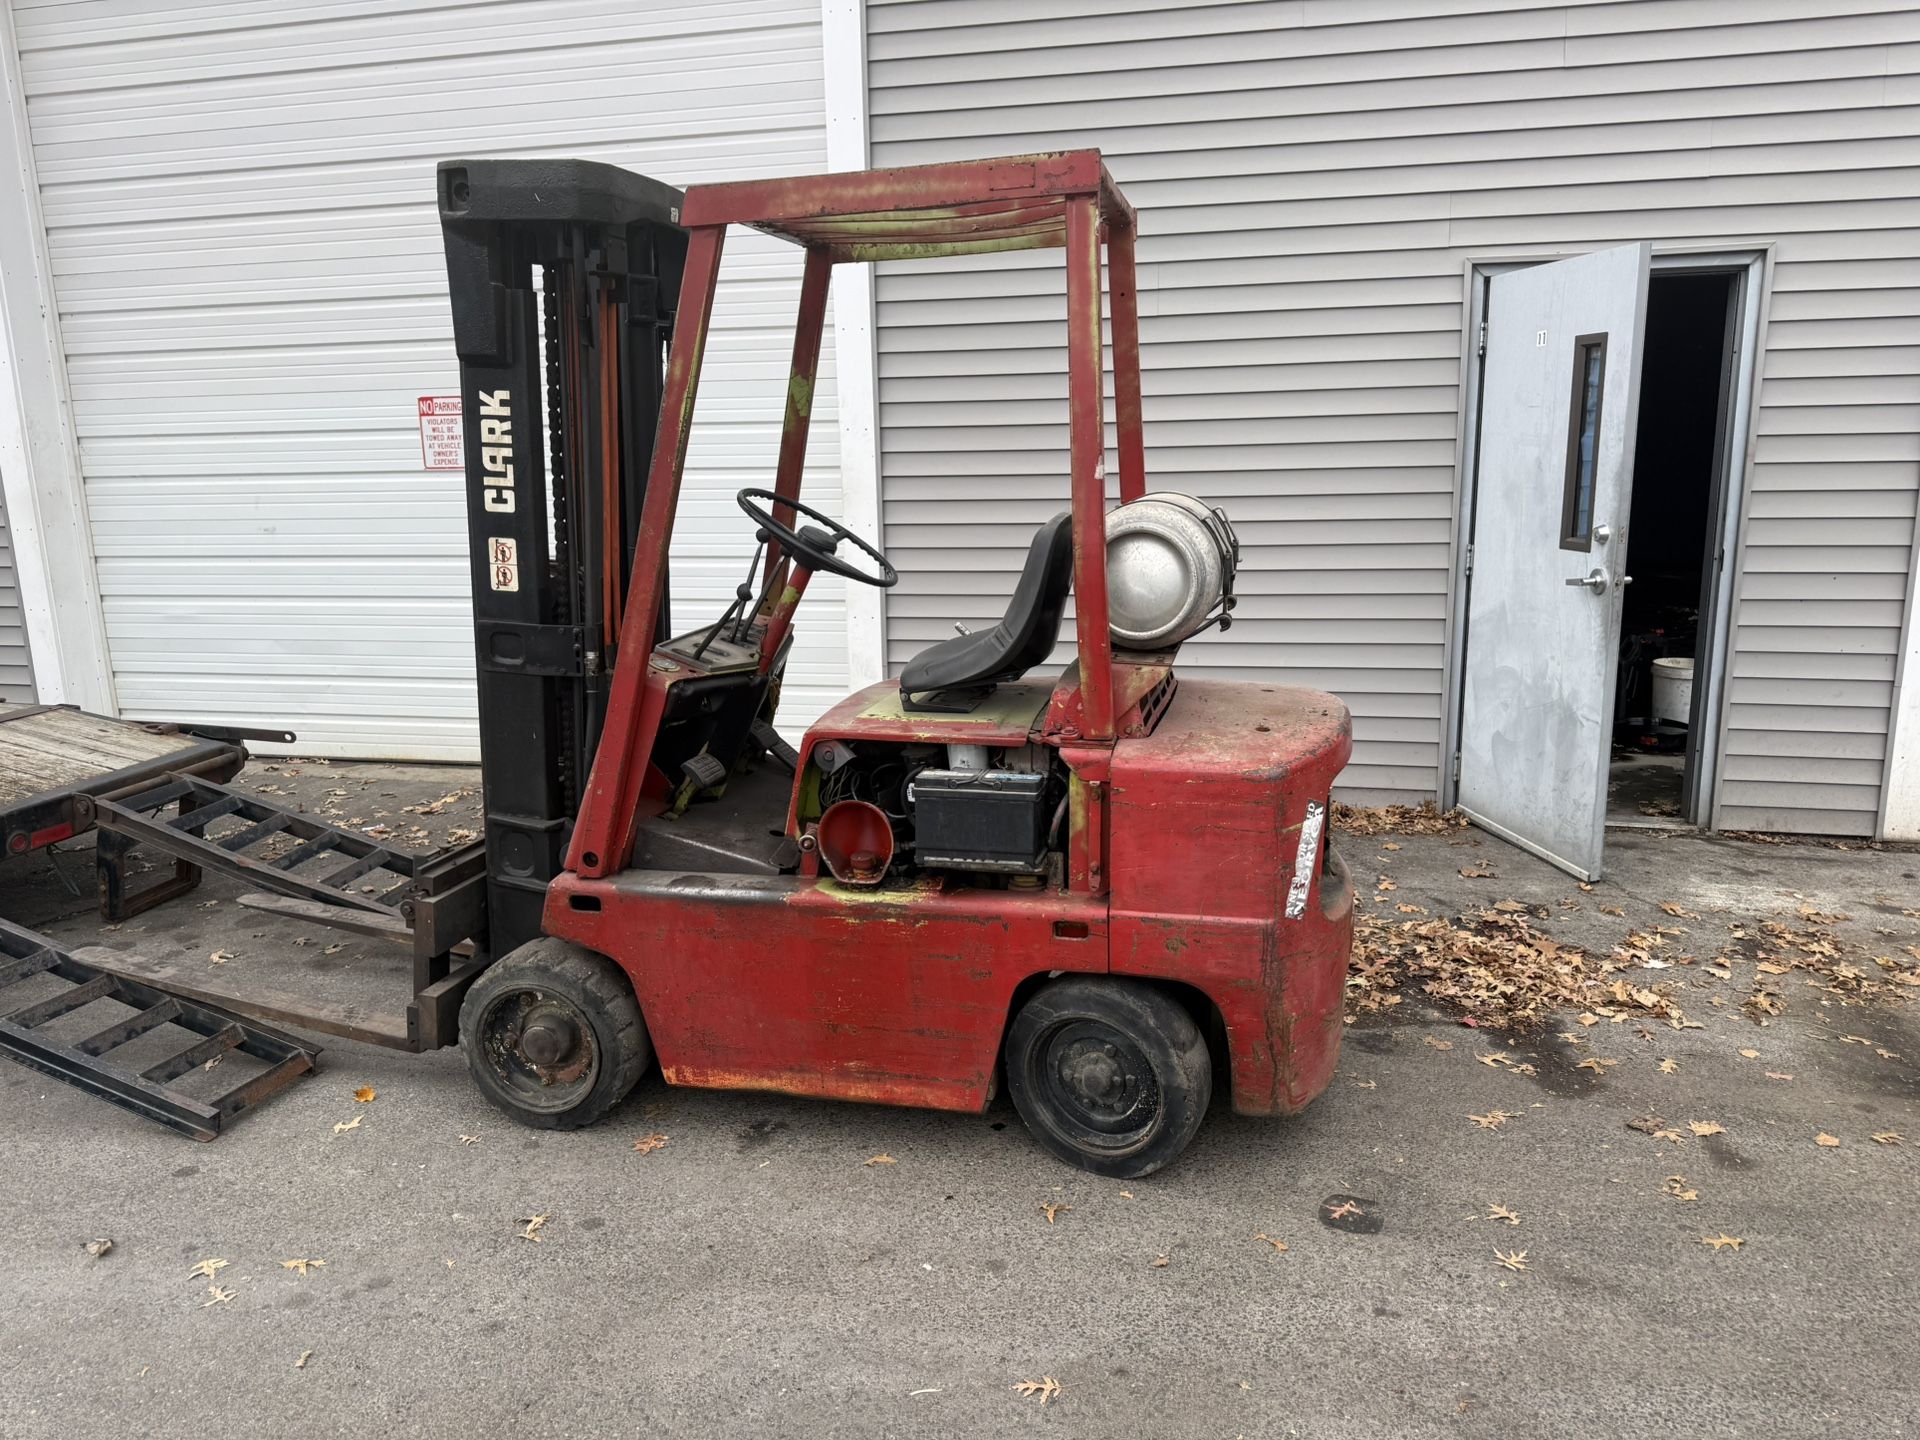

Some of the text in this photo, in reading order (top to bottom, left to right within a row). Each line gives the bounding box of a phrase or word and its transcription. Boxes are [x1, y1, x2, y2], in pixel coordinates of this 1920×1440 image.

[420, 400, 462, 414] NO PARKING
[427, 418, 458, 426] VIOLATORS
[437, 442, 462, 450] VEHICLE
[433, 450, 459, 458] OWNER'S
[479, 390, 515, 513] CLARK
